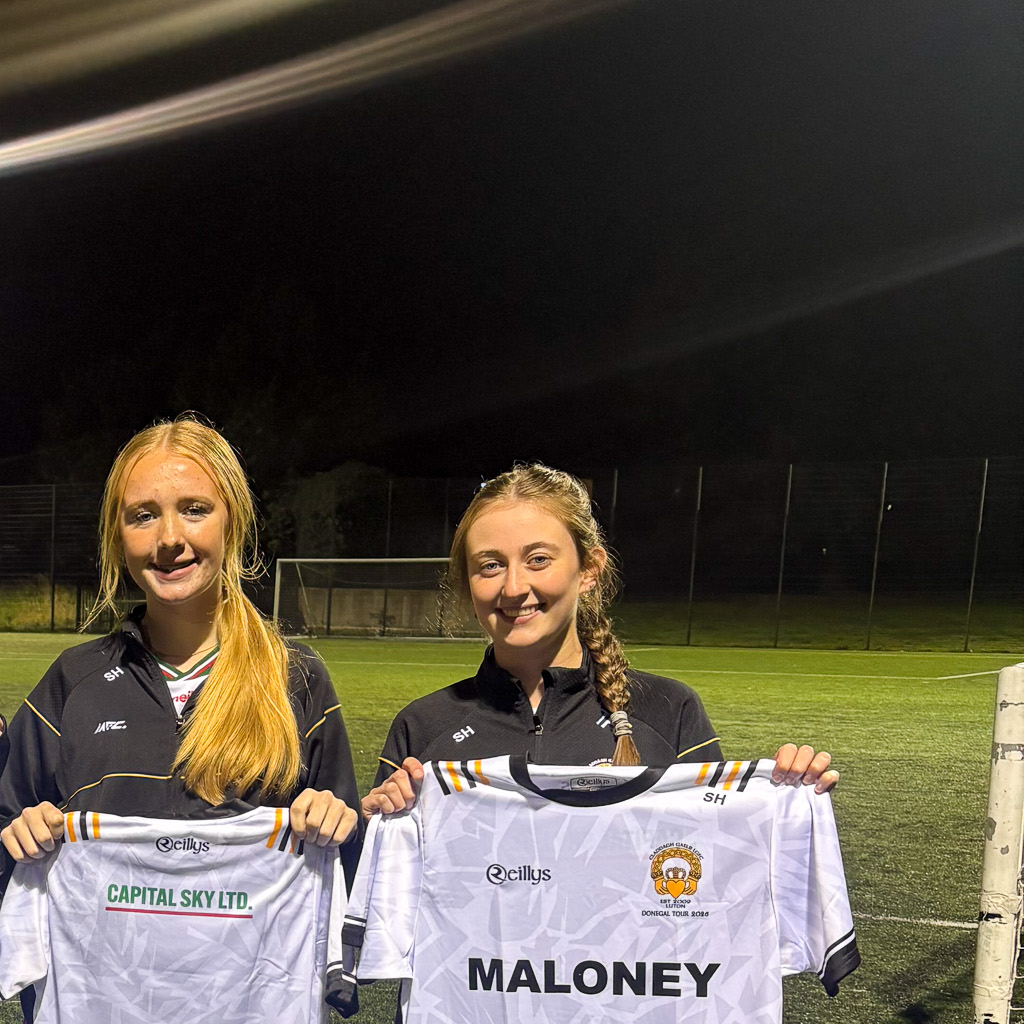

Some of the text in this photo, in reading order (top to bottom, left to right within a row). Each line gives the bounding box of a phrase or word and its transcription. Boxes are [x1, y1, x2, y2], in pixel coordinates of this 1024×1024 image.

[103, 666, 124, 682] SH
[452, 725, 475, 742] SH
[703, 792, 727, 805] SH
[156, 836, 210, 854] Reillys
[486, 863, 552, 885] Reillys
[107, 884, 253, 910] CAPITAL SKY LTD.
[469, 957, 721, 998] MALONEY
